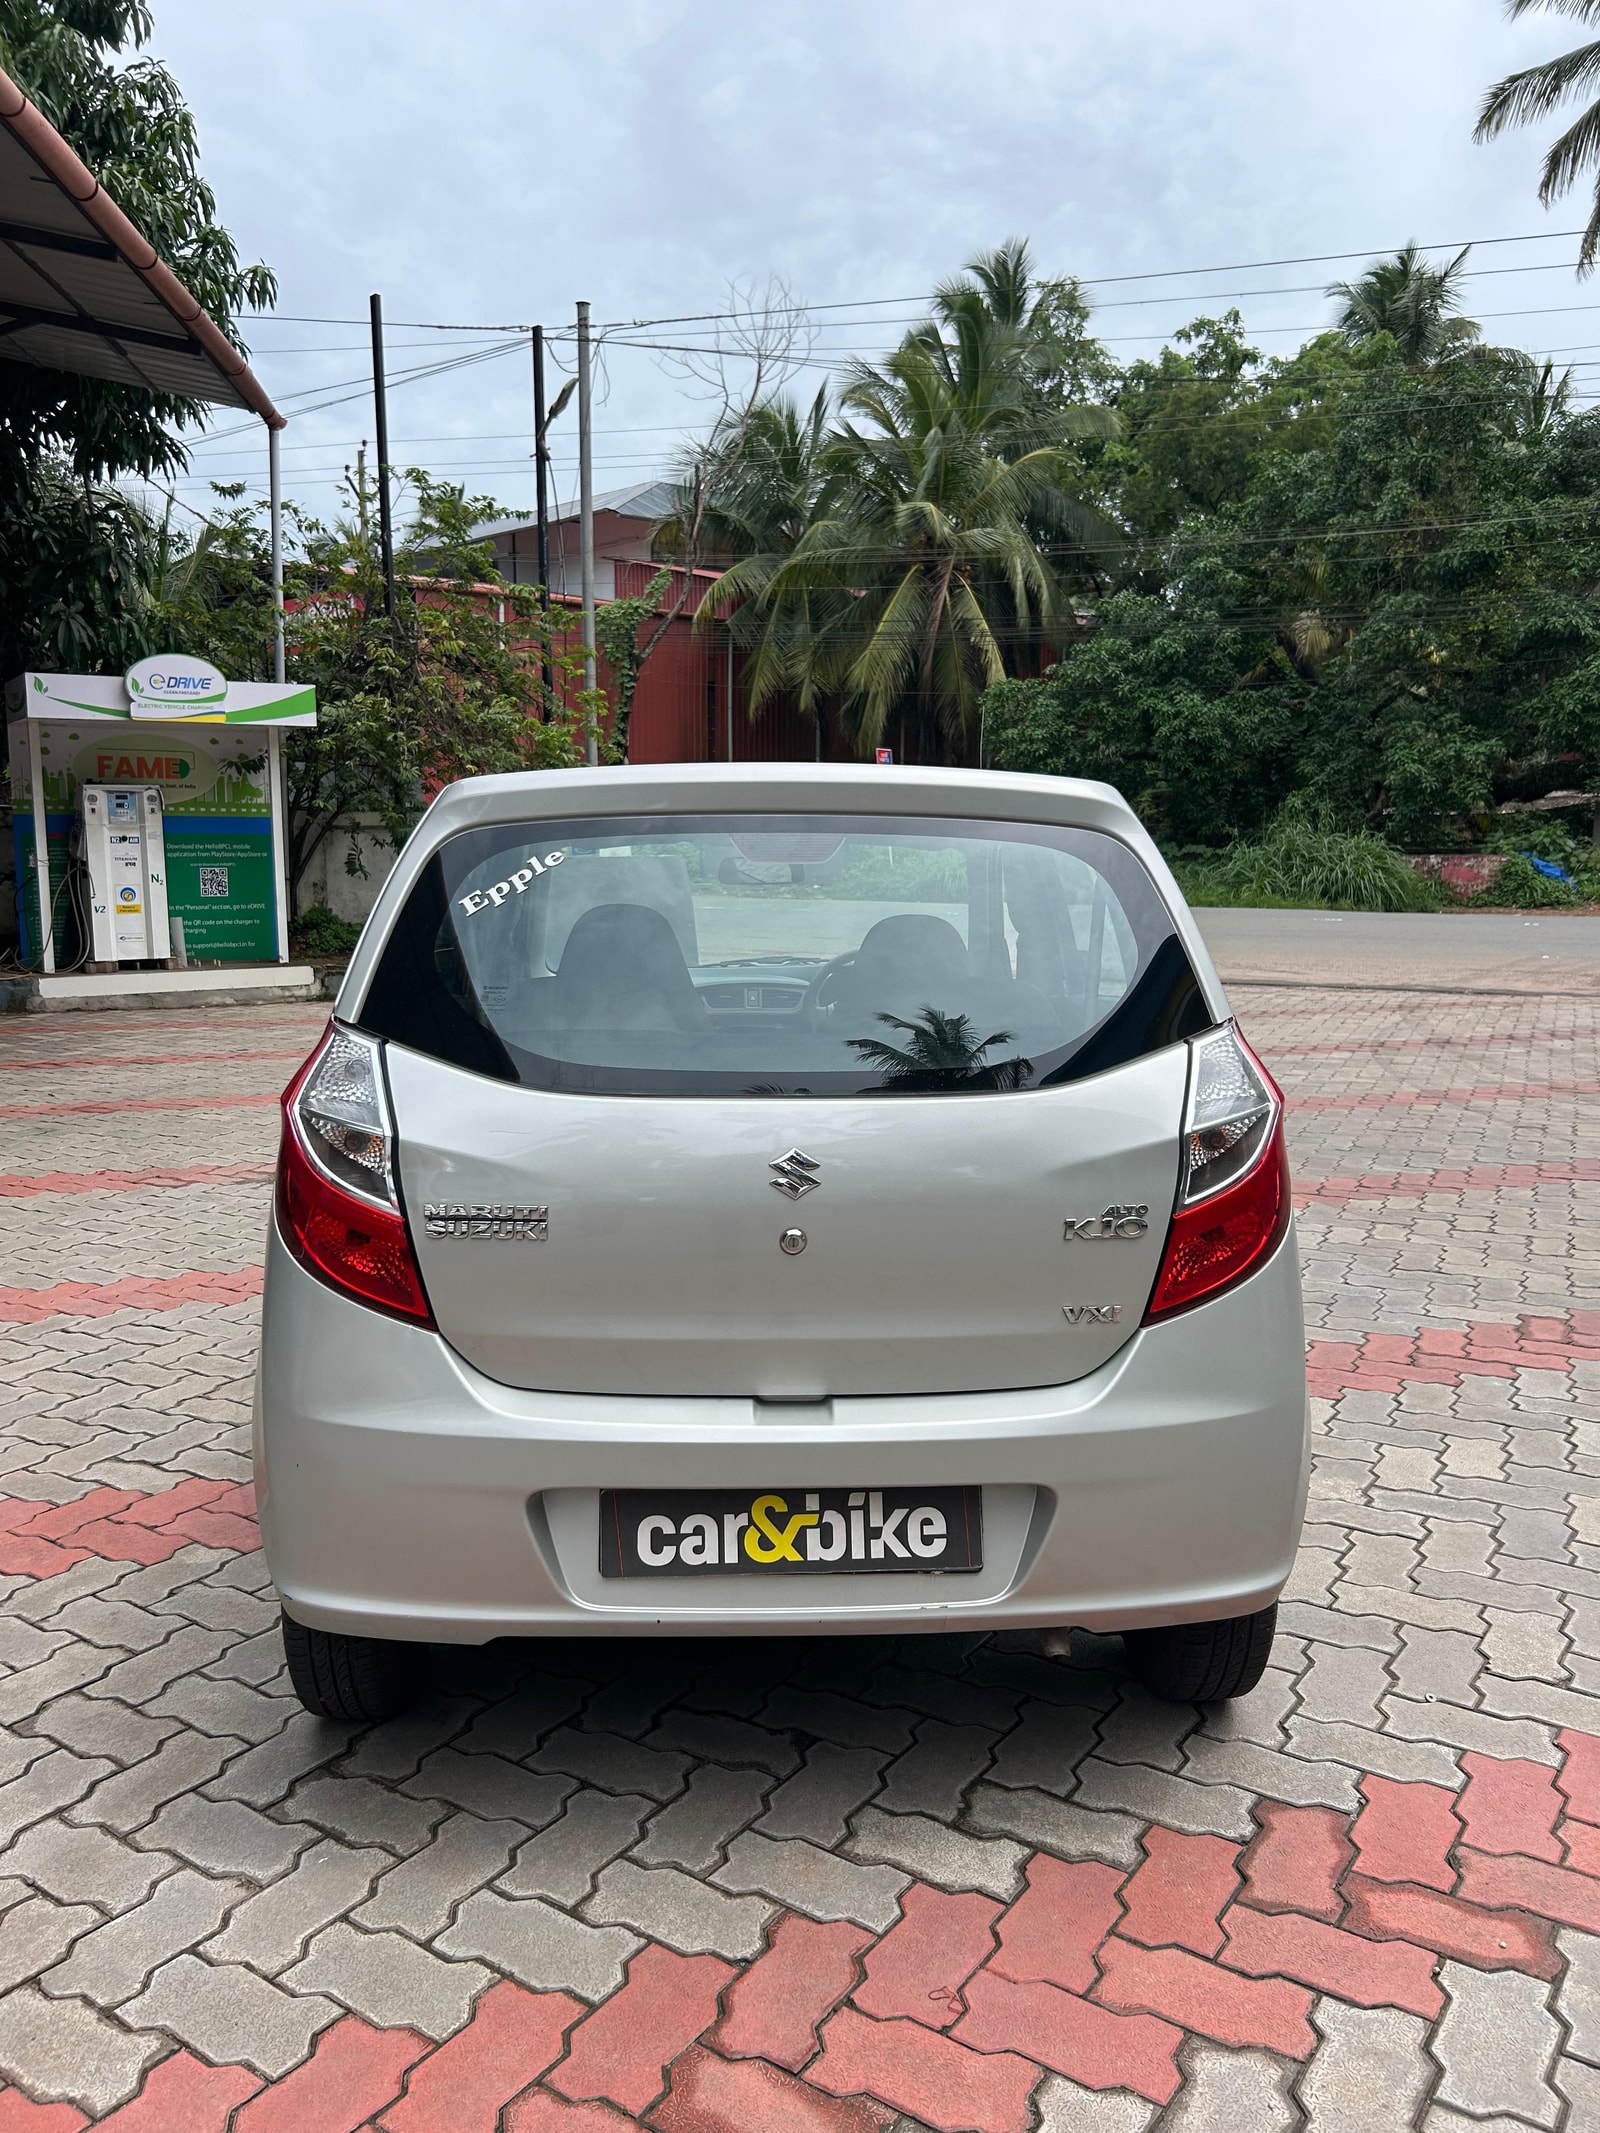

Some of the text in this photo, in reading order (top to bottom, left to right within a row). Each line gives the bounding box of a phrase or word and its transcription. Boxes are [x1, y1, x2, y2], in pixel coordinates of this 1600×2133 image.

[96, 755, 181, 780] FAME
[458, 851, 565, 917] Epple
[94, 905, 106, 914] V2
[424, 1203, 548, 1219] MARUTI
[1101, 1204, 1148, 1217] ALTO
[425, 1220, 548, 1240] SUZUKI
[1064, 1216, 1148, 1240] K10
[636, 1491, 947, 1567] car&bike
